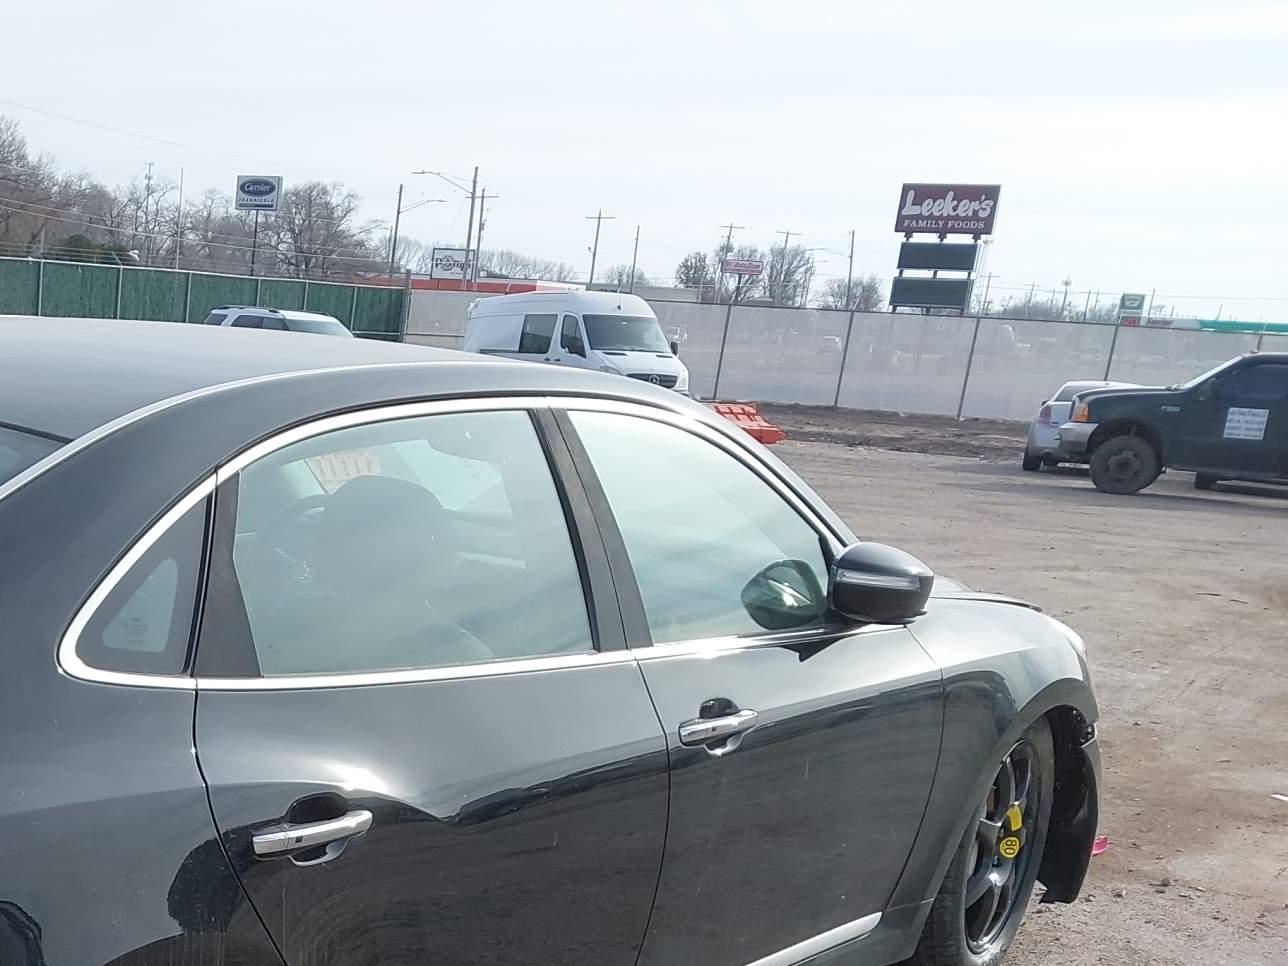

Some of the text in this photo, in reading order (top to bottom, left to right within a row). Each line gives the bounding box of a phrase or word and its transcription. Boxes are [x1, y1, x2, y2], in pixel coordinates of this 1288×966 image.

[244, 183, 272, 191] Carrier
[901, 190, 994, 217] Leeker's
[903, 219, 985, 229] FAMILY FOODS
